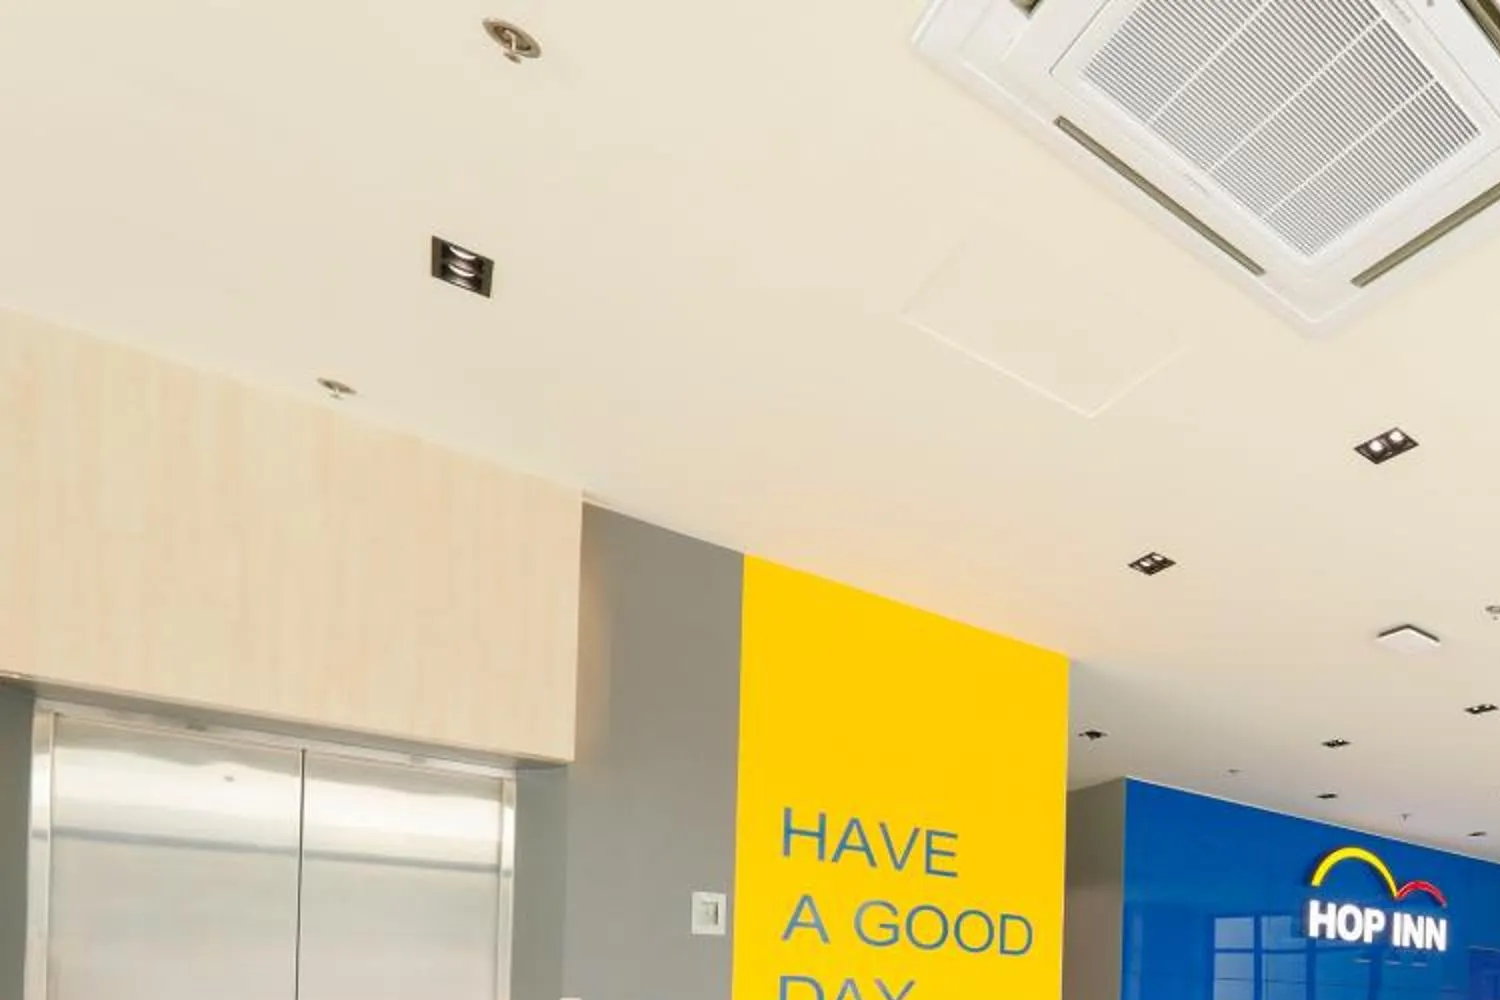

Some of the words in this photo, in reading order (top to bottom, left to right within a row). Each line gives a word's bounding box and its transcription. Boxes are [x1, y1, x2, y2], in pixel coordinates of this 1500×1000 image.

[781, 807, 959, 878] HAVE
[781, 894, 830, 944] A
[853, 900, 1033, 956] GOOD
[1308, 899, 1386, 944] HOP
[1392, 911, 1448, 952] INN
